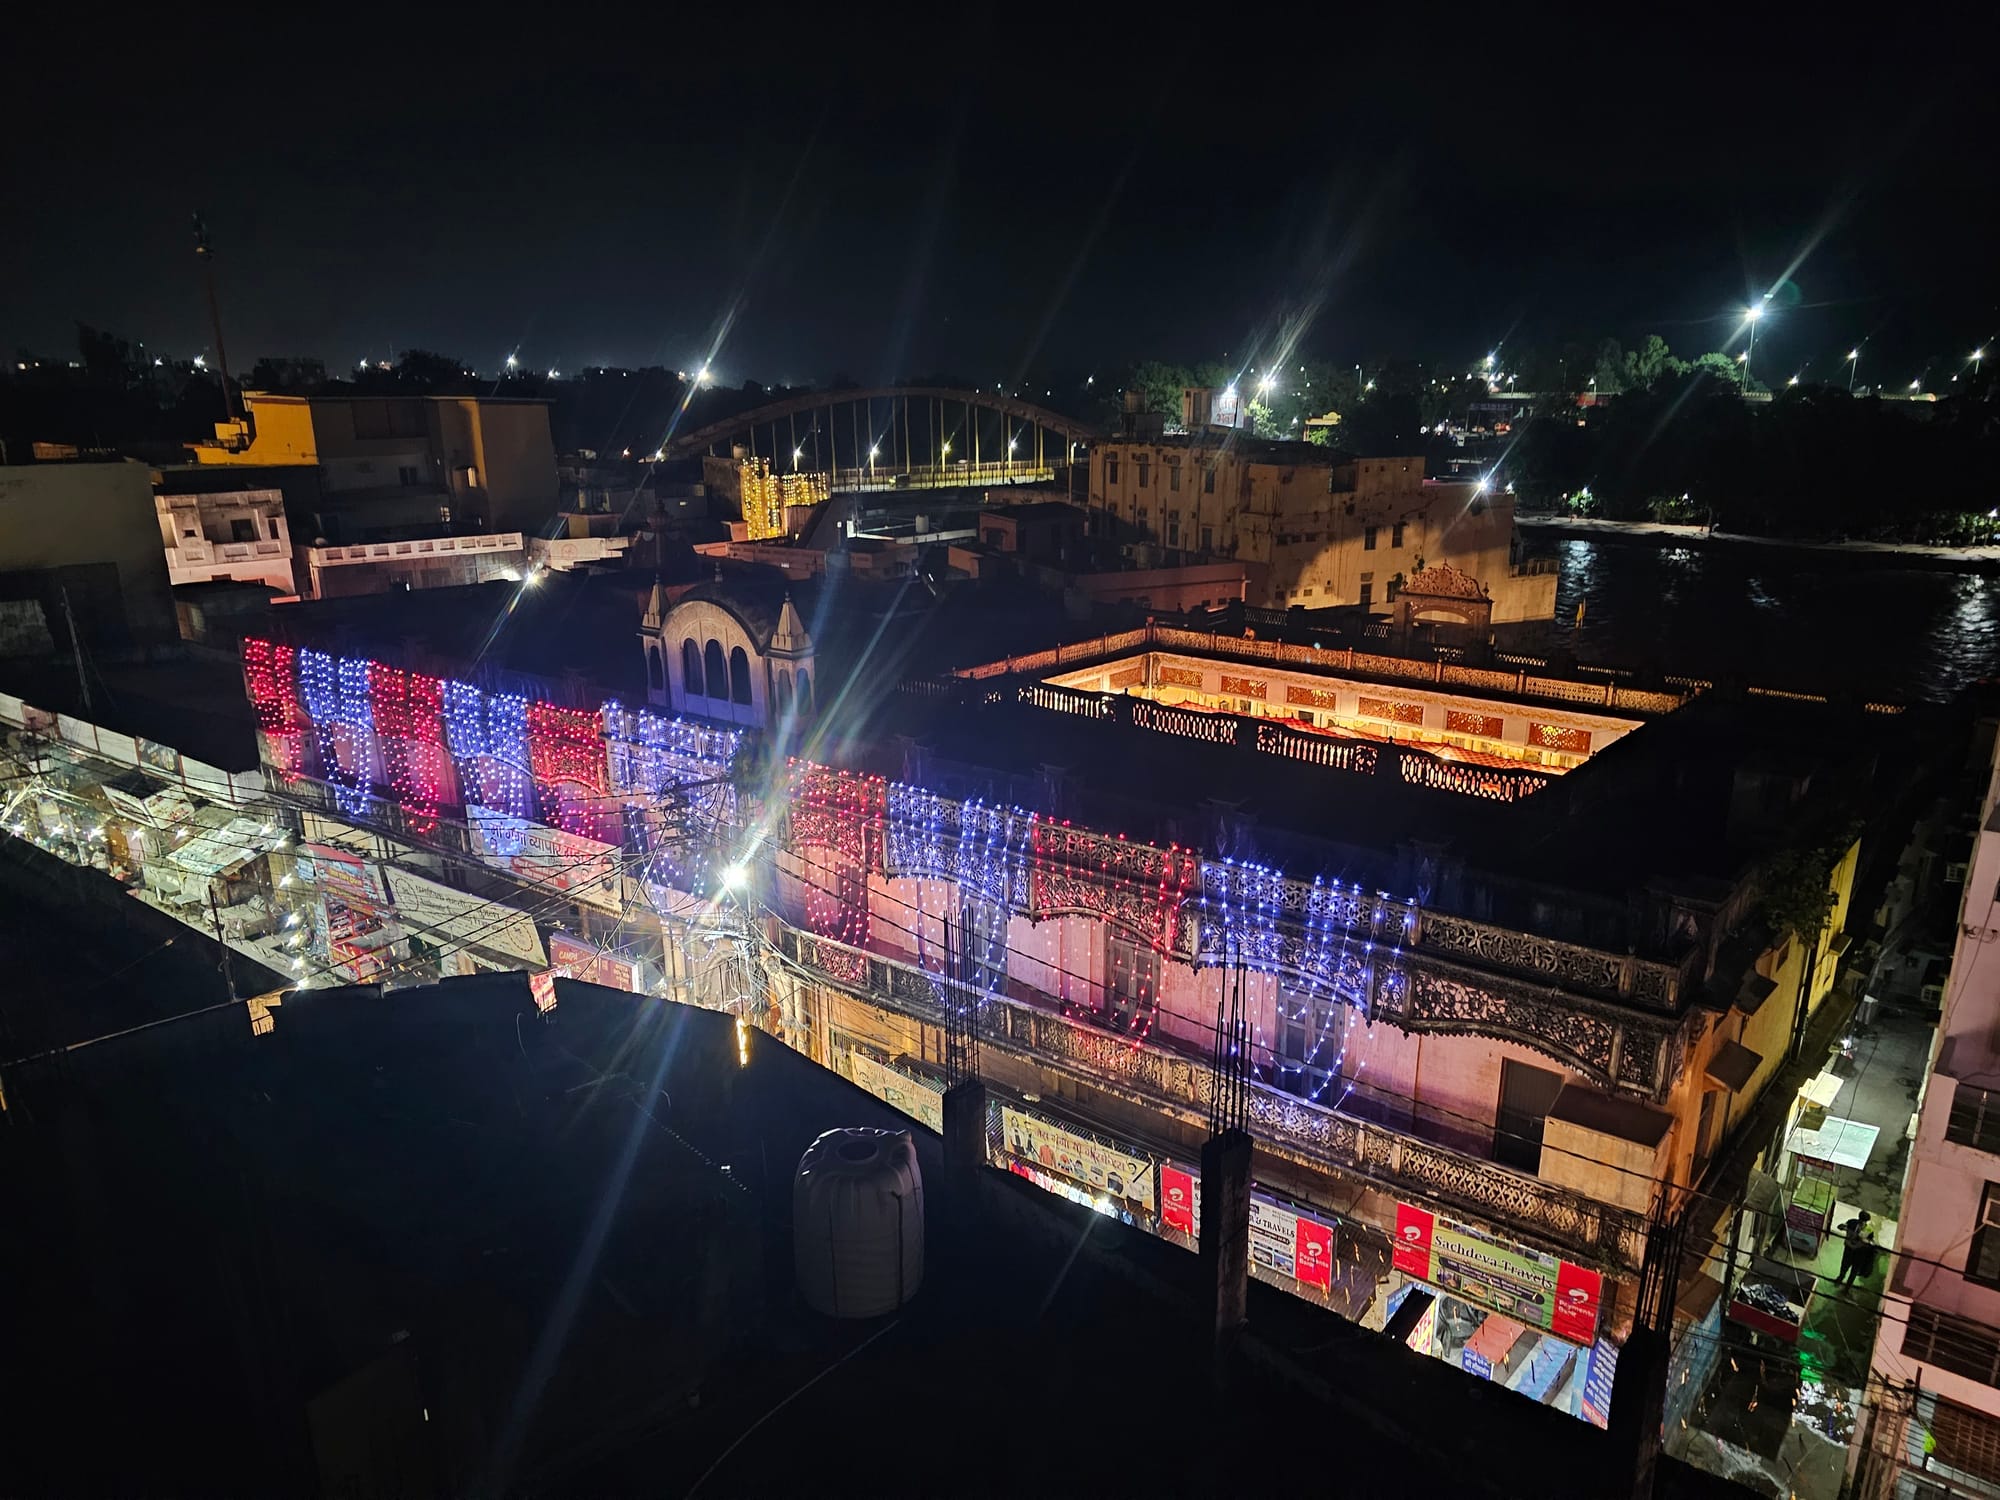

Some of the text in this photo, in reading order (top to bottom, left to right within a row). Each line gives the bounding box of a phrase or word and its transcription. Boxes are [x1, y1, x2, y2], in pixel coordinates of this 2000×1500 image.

[1263, 1219, 1296, 1238] TRAVELS
[1435, 1235, 1498, 1268] Sachdeva
[1501, 1260, 1554, 1289] Travels
